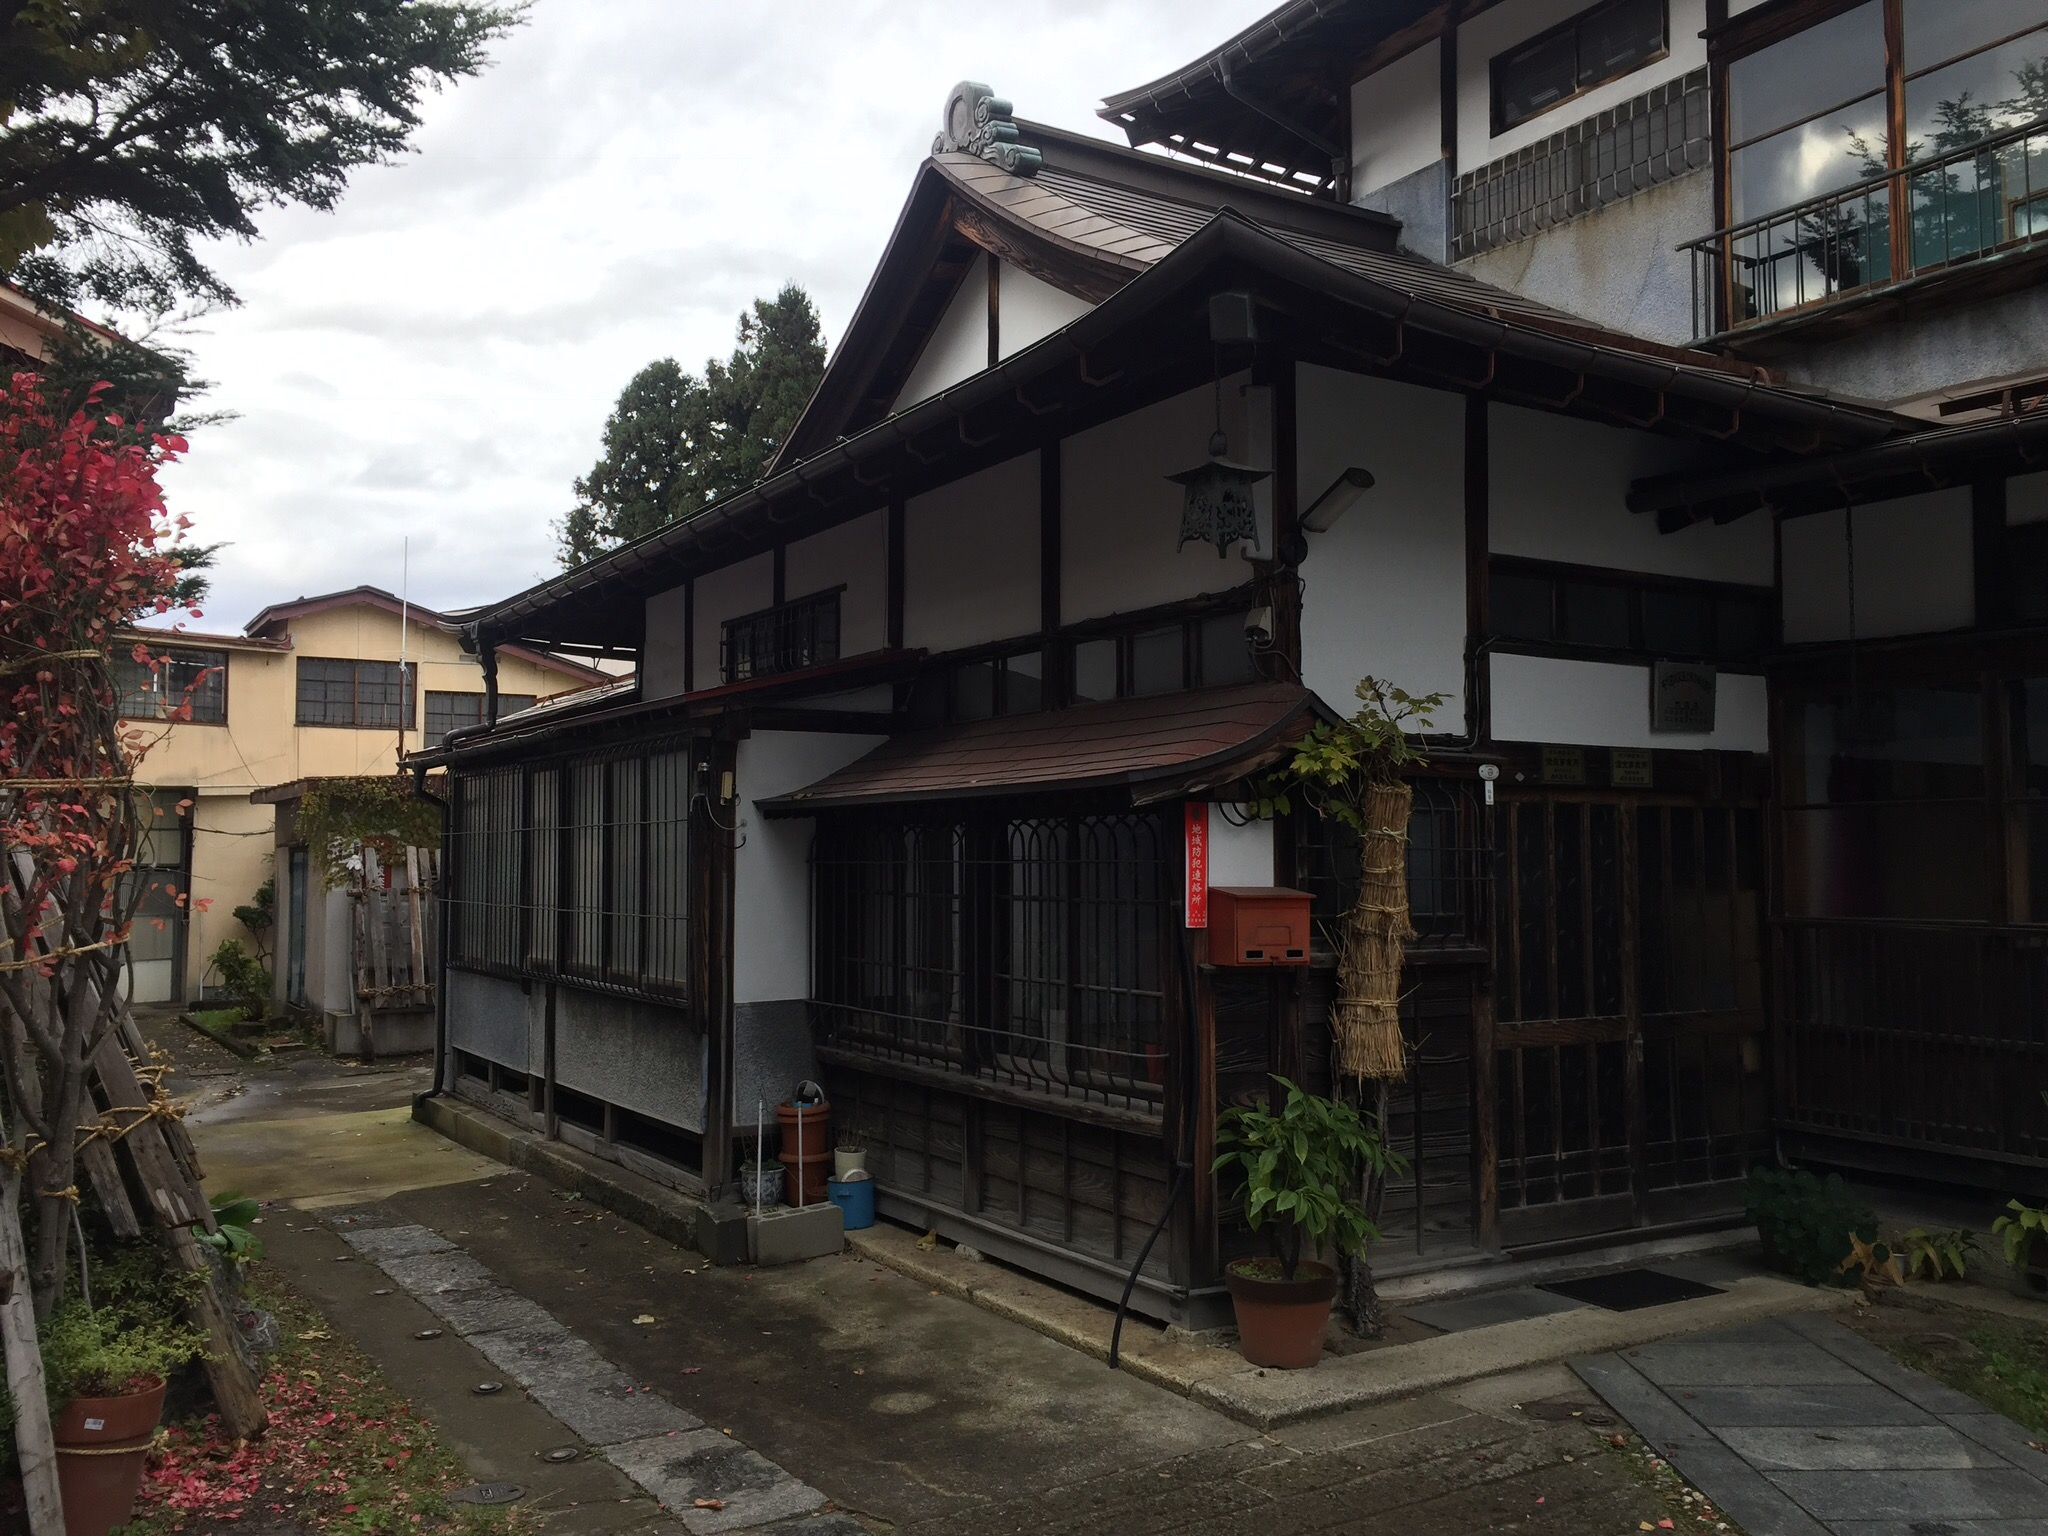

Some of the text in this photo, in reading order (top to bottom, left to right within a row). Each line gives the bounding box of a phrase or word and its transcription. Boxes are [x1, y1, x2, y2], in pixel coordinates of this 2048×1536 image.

[1191, 824, 1203, 906] 地域防犯連絡所
